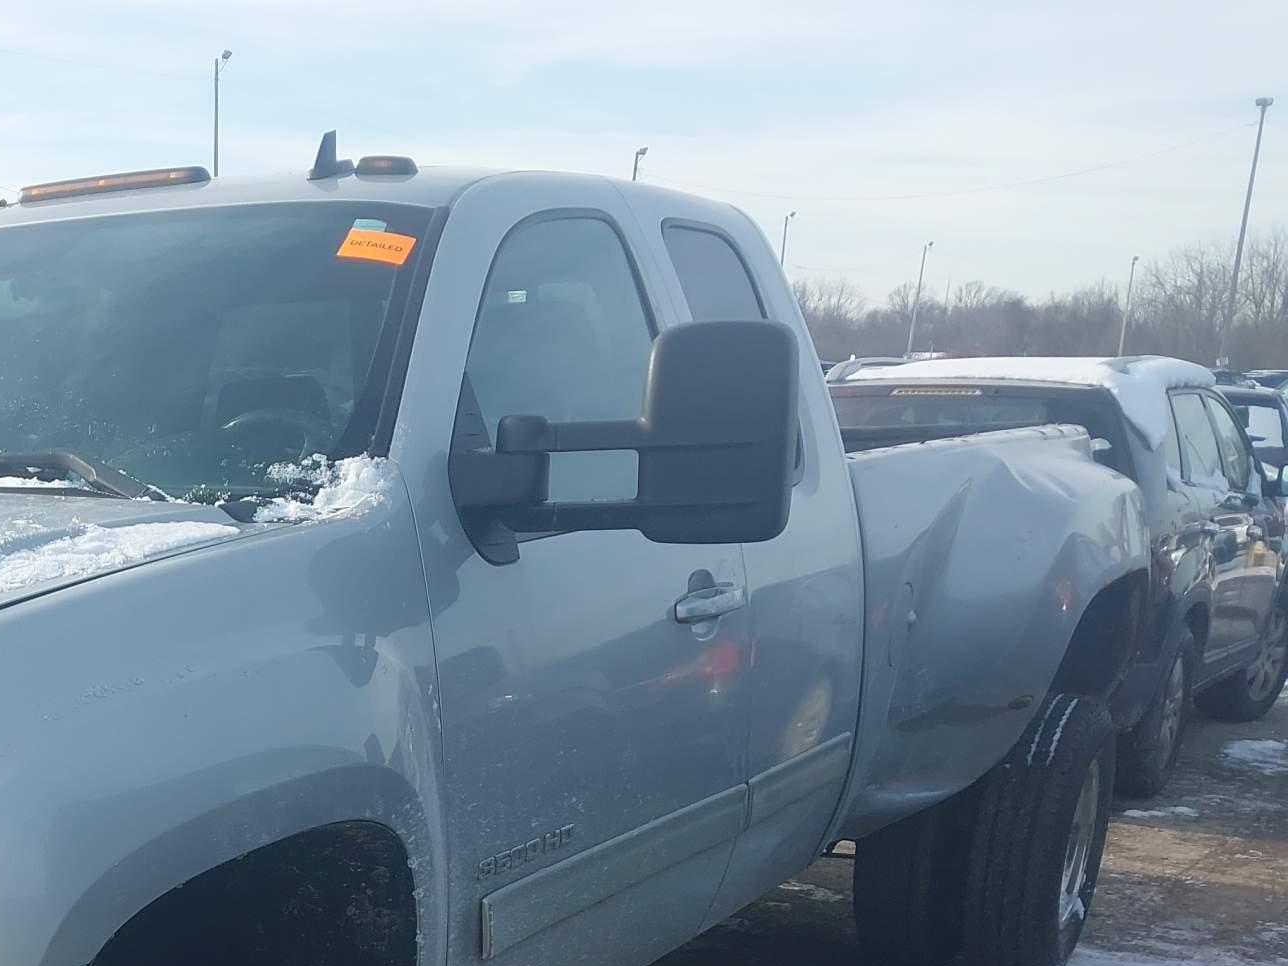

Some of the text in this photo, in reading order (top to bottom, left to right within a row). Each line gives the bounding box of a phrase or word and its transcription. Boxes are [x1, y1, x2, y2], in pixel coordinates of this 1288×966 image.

[349, 239, 404, 252] DETAILED
[476, 823, 575, 880] 3500 HD
